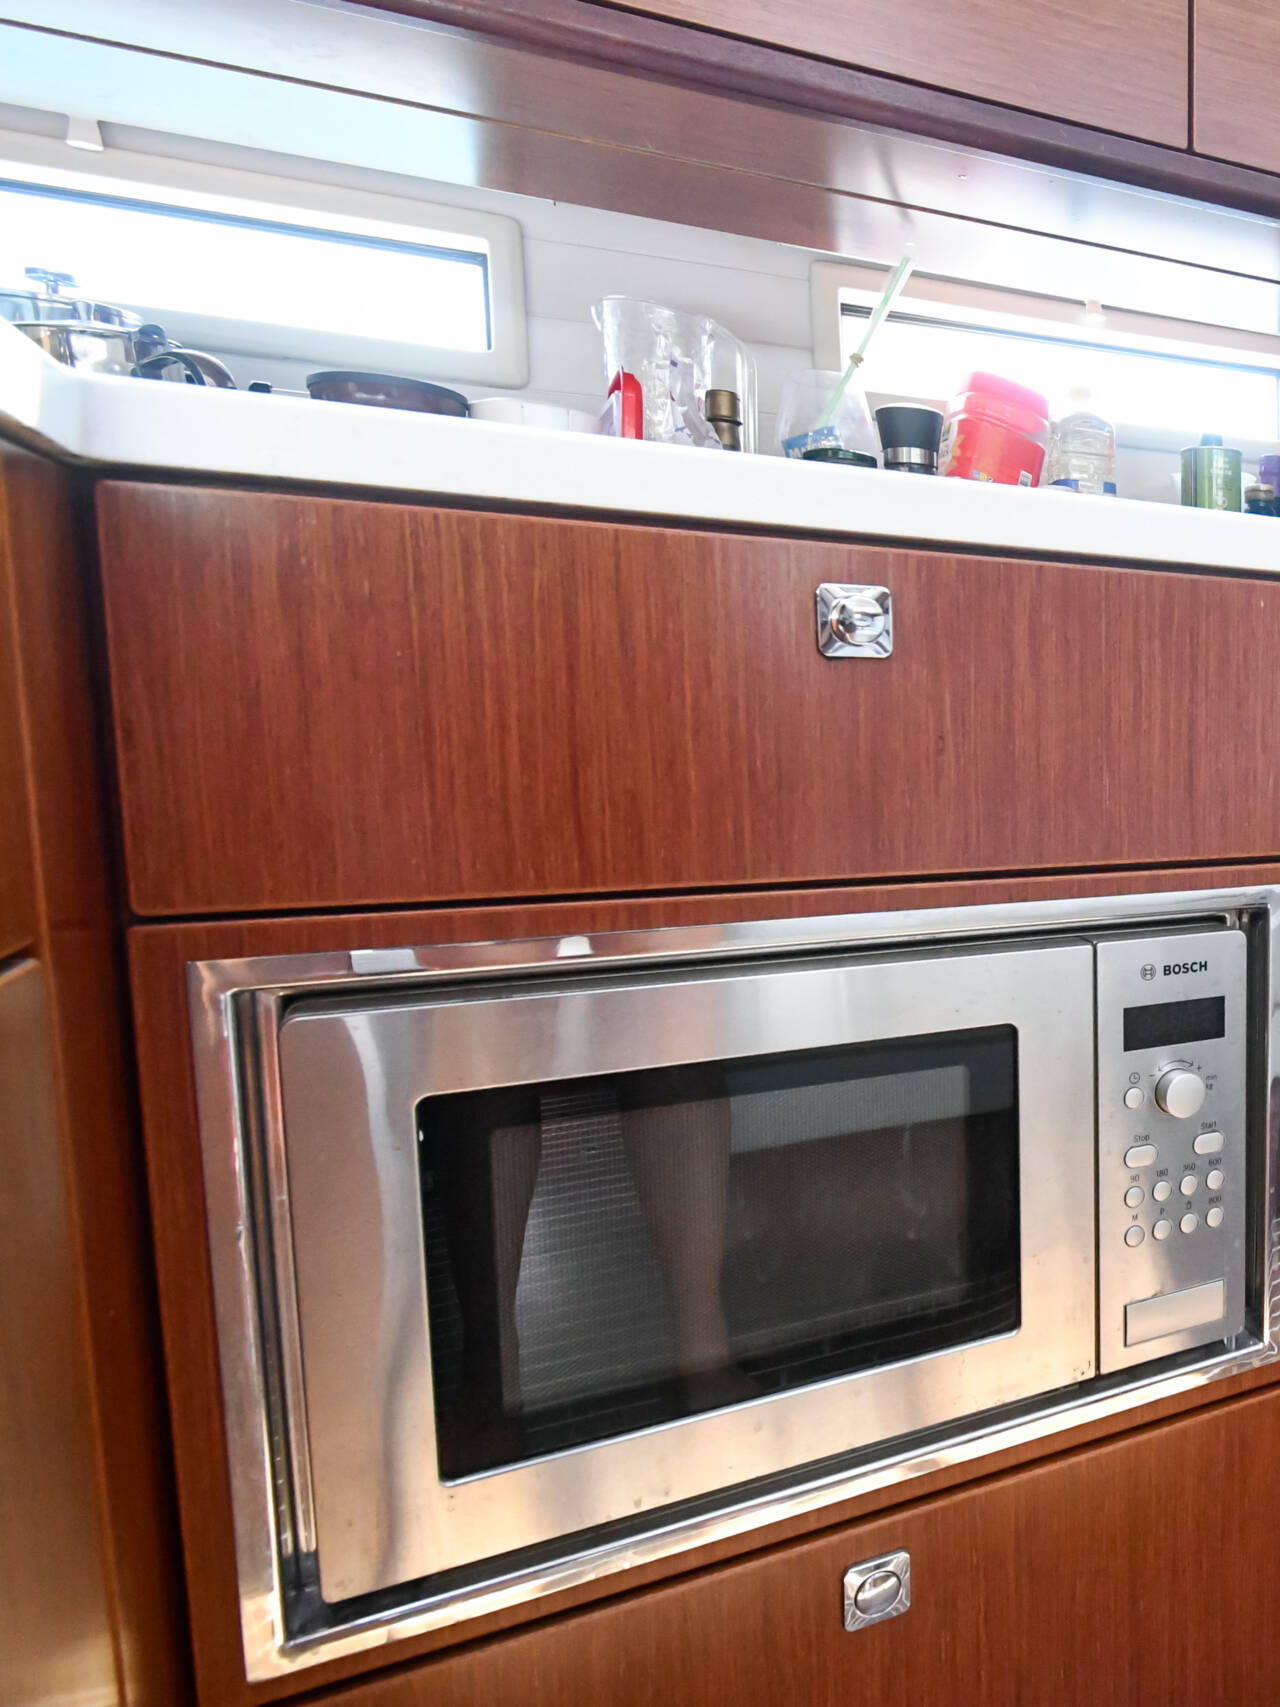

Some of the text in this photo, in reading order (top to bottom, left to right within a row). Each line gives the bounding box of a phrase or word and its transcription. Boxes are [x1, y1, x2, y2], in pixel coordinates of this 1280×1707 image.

[1162, 960, 1208, 976] BOSCH
[1201, 1121, 1217, 1130] Start
[1134, 1134, 1150, 1143] Stop
[1156, 1168, 1169, 1177] 180
